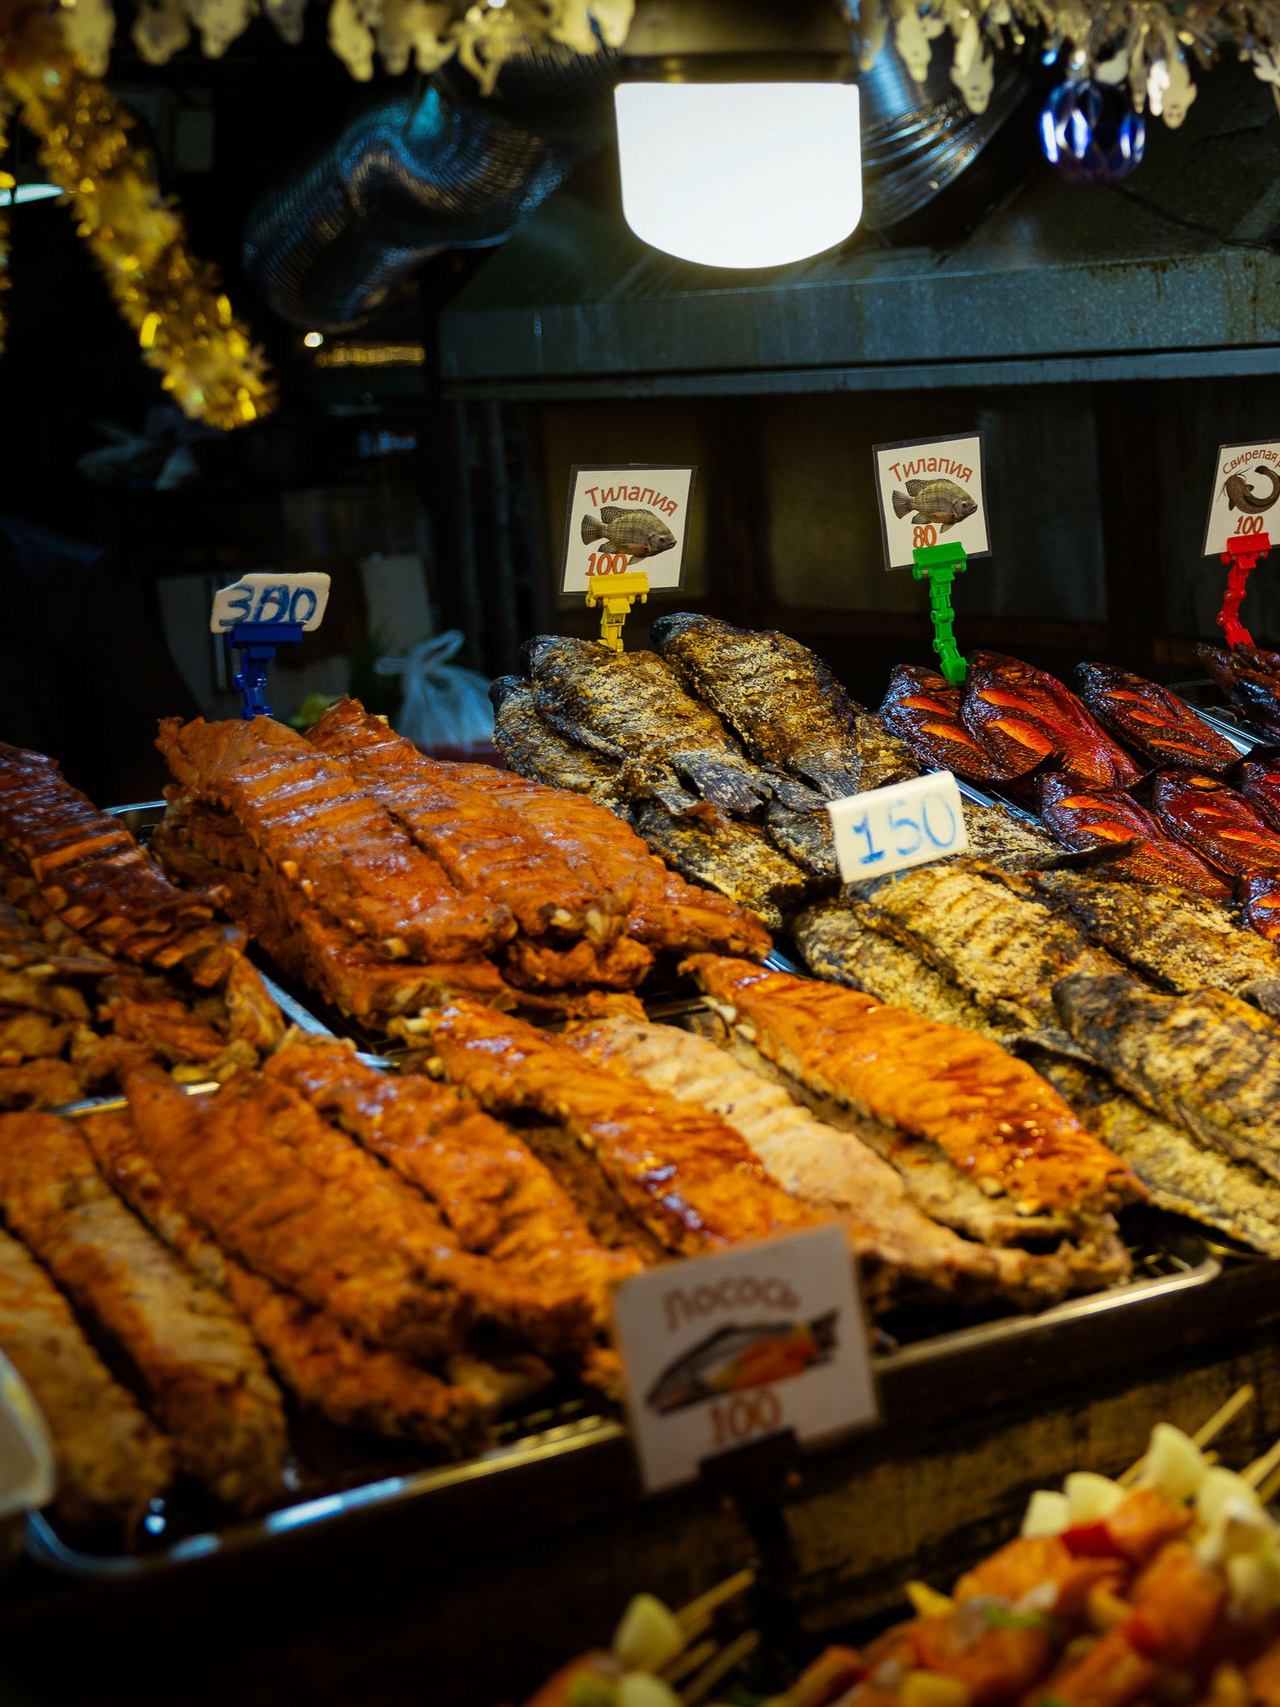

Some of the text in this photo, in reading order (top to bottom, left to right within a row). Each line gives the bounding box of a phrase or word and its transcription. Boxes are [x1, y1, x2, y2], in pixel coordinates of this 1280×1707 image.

[887, 456, 974, 484] Тилапия
[1222, 449, 1279, 475] Свирепая
[584, 485, 679, 518] Тилапия
[912, 524, 937, 549] 80
[1233, 515, 1264, 535] 100
[584, 552, 627, 577] 100
[852, 791, 957, 865] 150
[709, 1387, 782, 1446] 100
